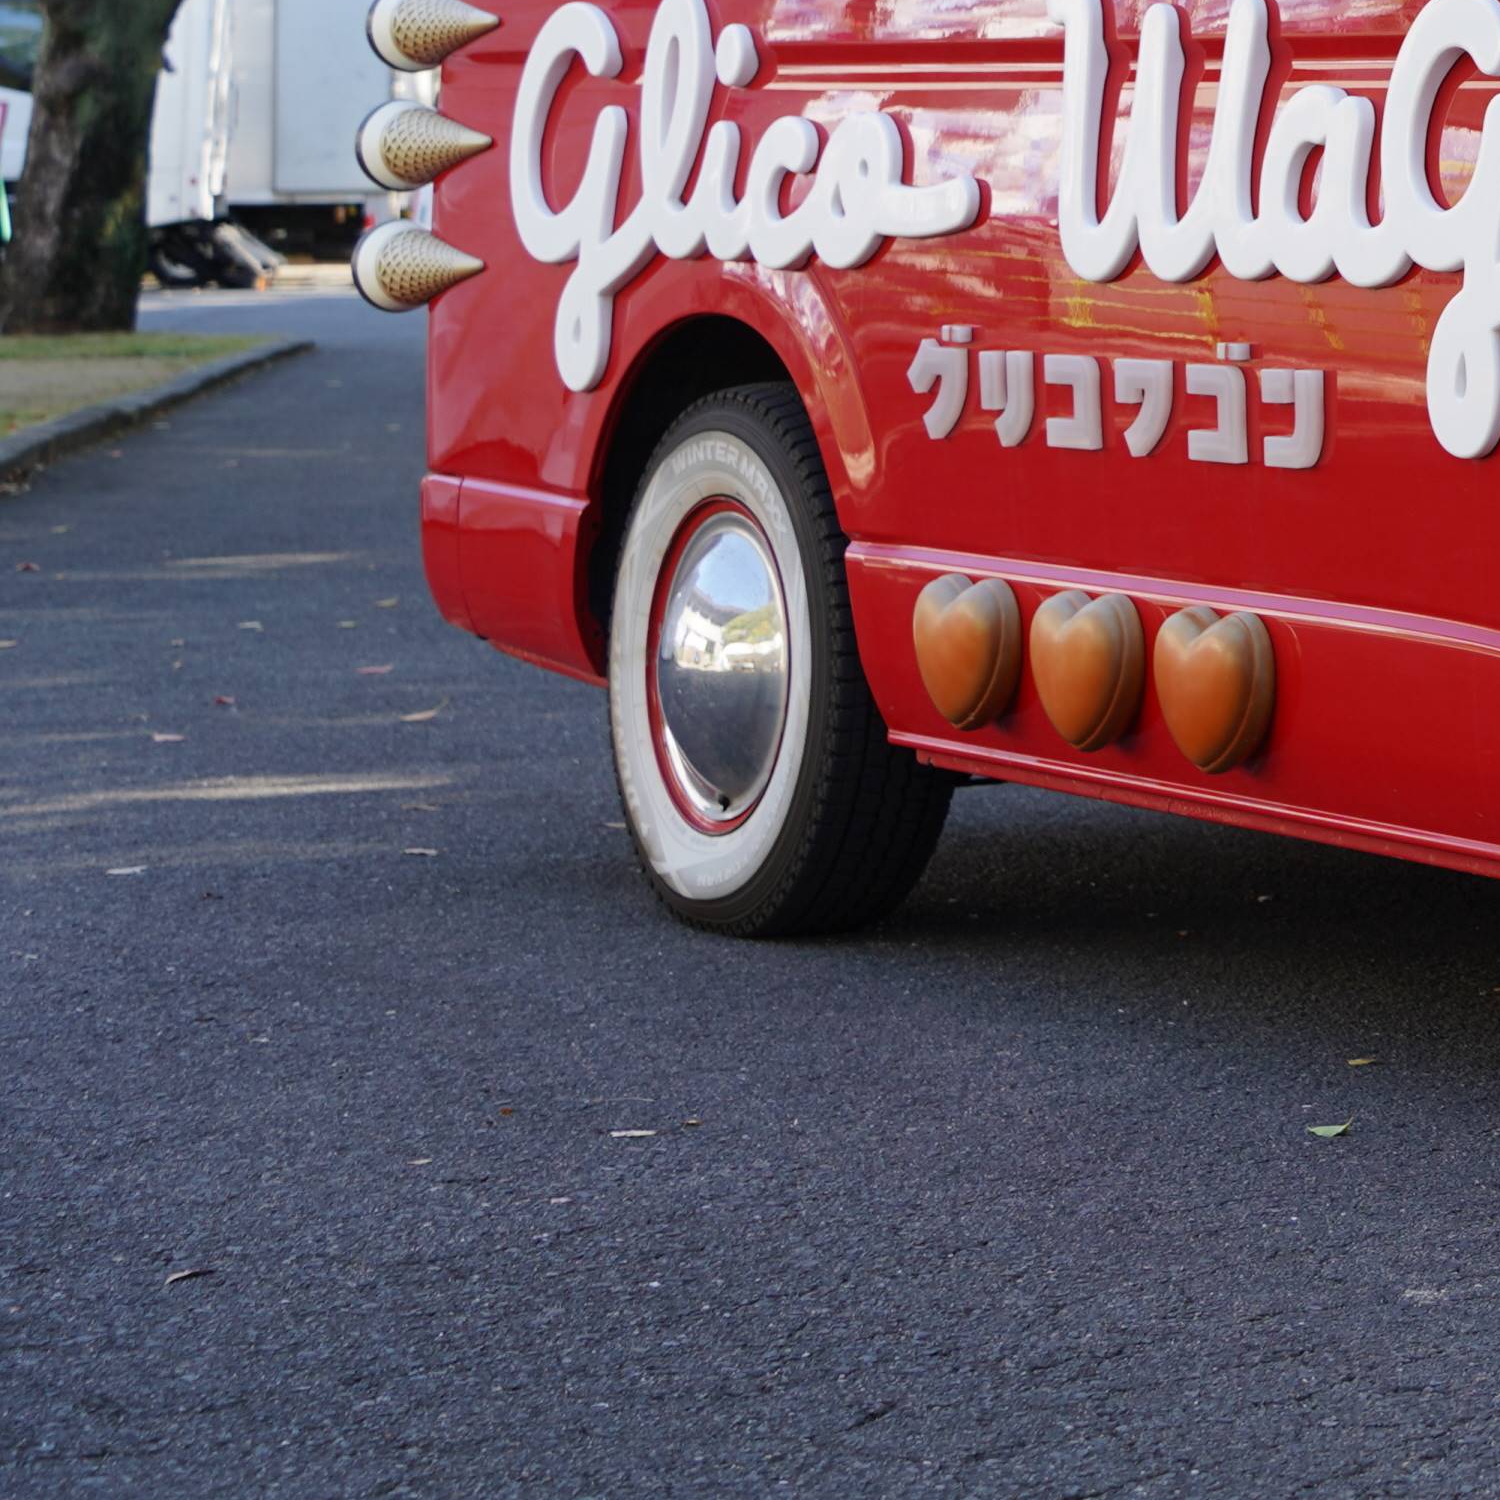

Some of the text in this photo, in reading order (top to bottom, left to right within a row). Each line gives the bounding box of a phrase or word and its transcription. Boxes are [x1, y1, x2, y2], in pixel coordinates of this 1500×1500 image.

[906, 324, 1325, 470] グリコワゴン
[671, 440, 740, 475] WINTER
